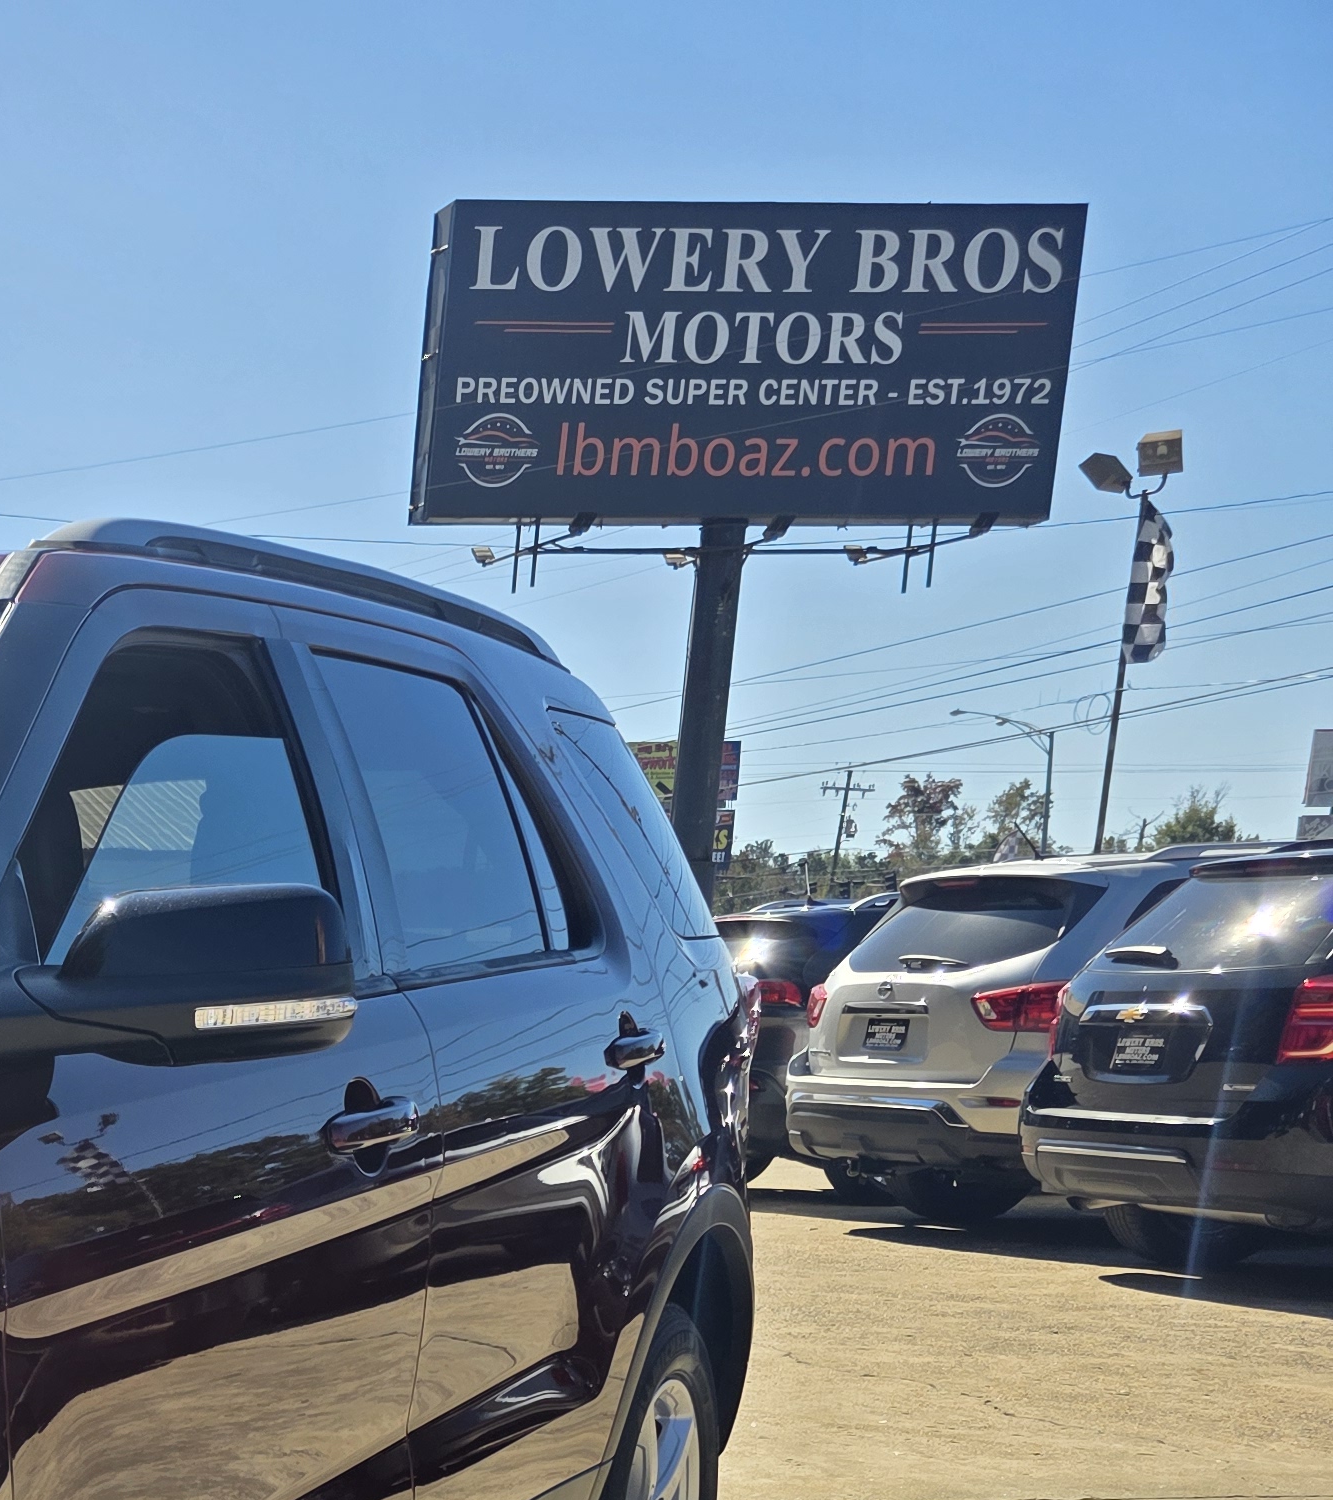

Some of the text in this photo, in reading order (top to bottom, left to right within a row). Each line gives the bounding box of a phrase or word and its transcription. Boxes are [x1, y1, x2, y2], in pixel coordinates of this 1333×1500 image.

[469, 226, 1064, 294] LOWERY BROS
[619, 311, 904, 365] MOTORS
[455, 377, 635, 405] PREOWNED
[644, 378, 748, 406] SUPER
[758, 378, 879, 406] CENTER
[907, 378, 1051, 406] EST.1972
[455, 447, 539, 457] LOWERY BROTHERS
[556, 422, 935, 478] lbmboaz.com
